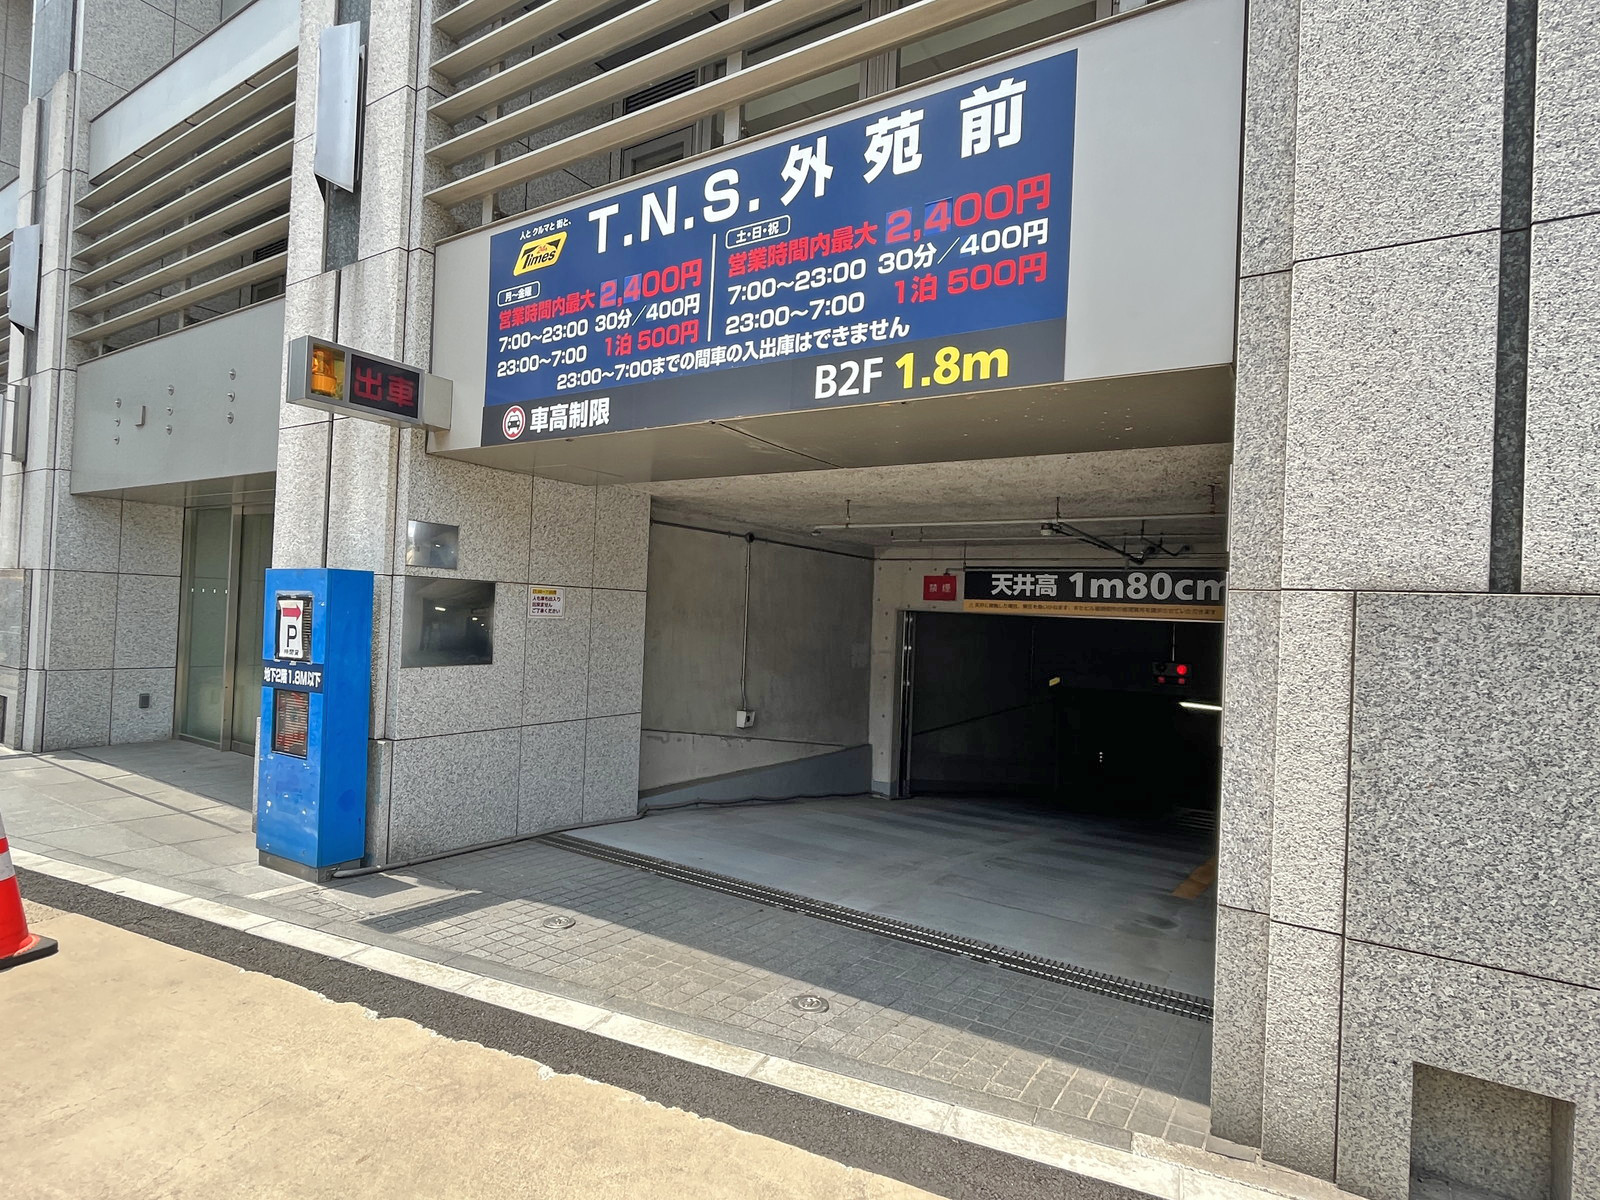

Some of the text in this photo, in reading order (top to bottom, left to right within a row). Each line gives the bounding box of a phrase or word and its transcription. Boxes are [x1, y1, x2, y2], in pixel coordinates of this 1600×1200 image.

[588, 77, 1028, 255] T.N.S. 外苑前
[727, 172, 1051, 278] 営業時間内最大 2,400円
[522, 250, 556, 269] Times
[894, 274, 937, 304] 1泊
[947, 251, 1047, 295] 500円
[498, 258, 703, 330] 営業時間内最大 2,400円
[604, 335, 632, 357] 1泊
[637, 319, 699, 351] 500円
[353, 367, 415, 407] 出車
[814, 346, 1010, 400] B2F 1.8m
[529, 397, 610, 433] 車高制限
[991, 571, 1226, 601] 天井高 1m80cm
[286, 624, 298, 648] P
